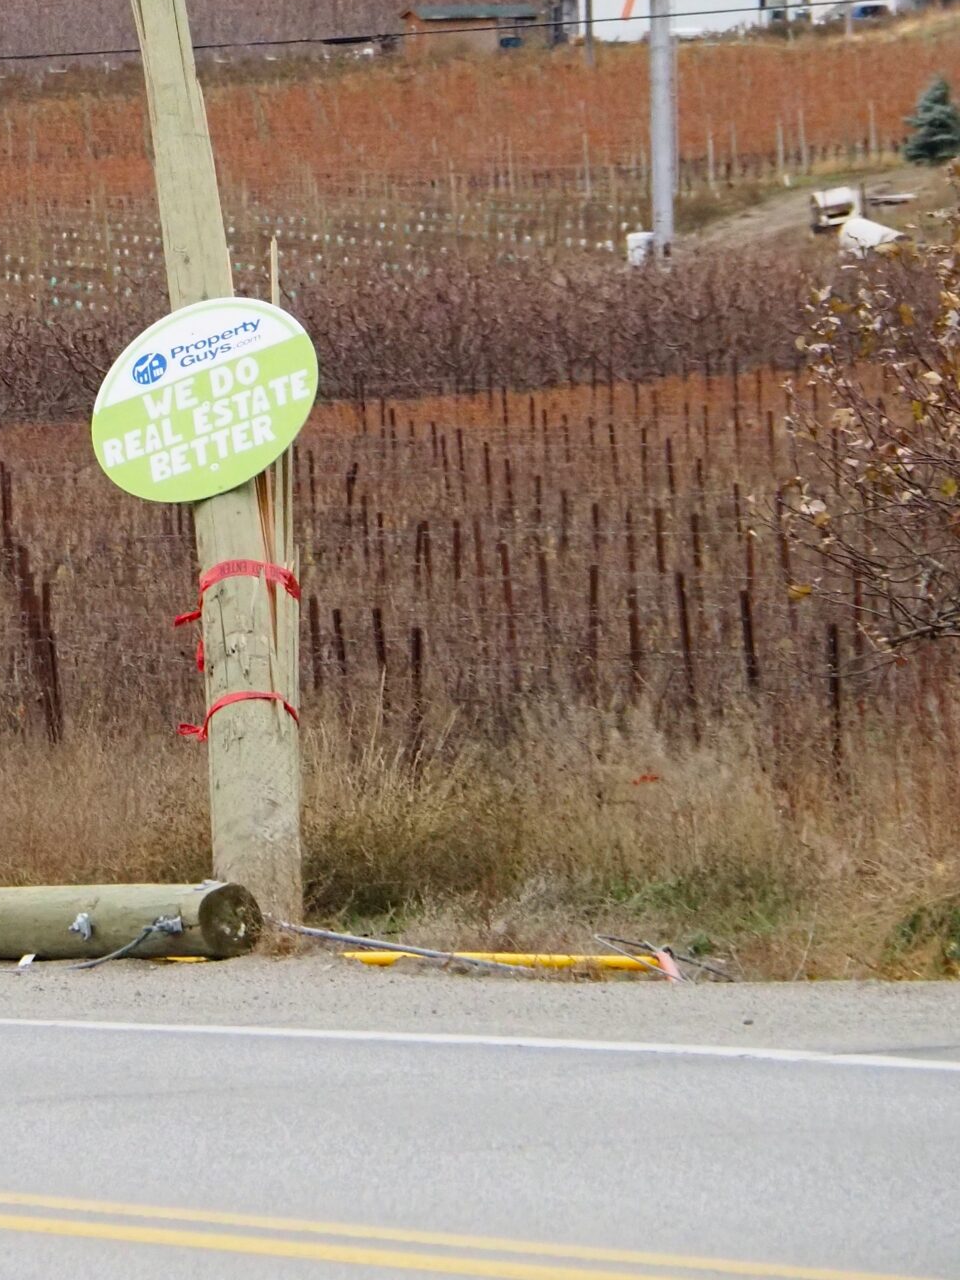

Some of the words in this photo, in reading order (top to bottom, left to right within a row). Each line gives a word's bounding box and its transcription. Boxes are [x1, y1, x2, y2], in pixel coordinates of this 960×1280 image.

[170, 319, 261, 359] Property
[103, 418, 183, 468] REAL
[193, 369, 311, 436] ESTATE
[142, 377, 199, 420] WE
[209, 356, 259, 399] DO
[150, 415, 276, 483] BETTER
